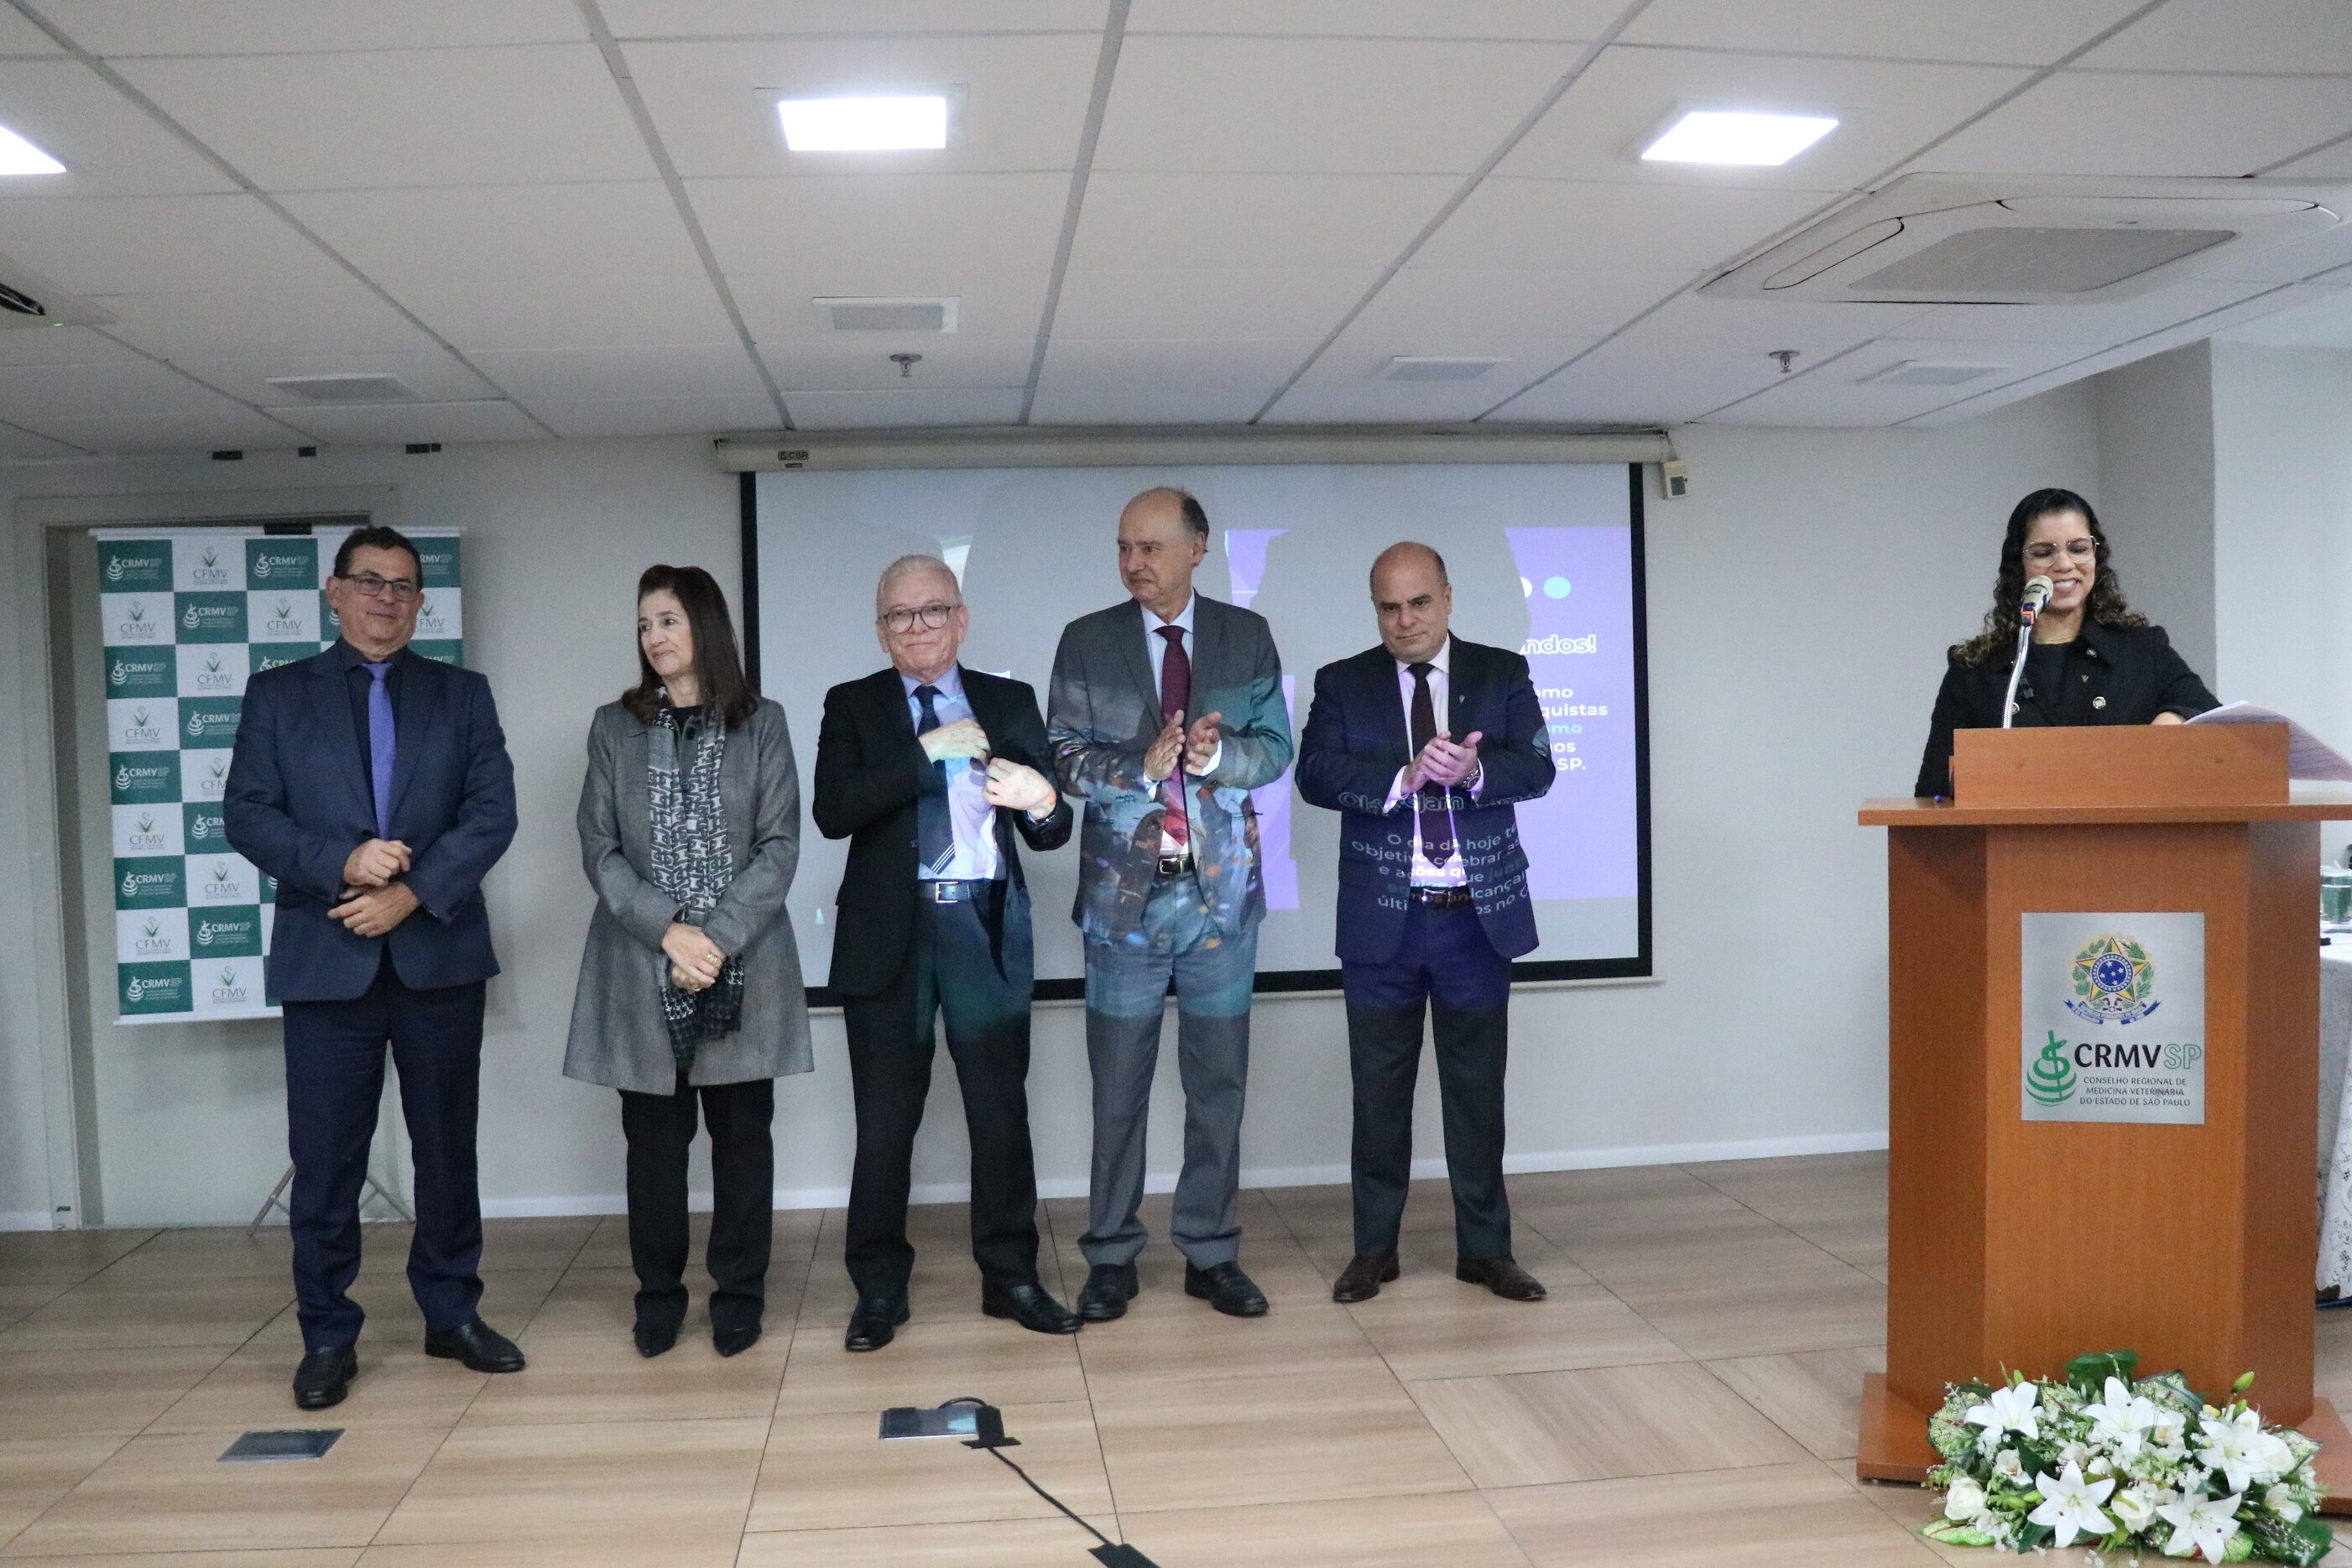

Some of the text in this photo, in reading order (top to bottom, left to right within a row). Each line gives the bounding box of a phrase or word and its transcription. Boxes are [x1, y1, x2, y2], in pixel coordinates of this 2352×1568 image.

[193, 569, 228, 579] CFMV
[120, 623, 156, 633] CFMV
[267, 620, 301, 630] CFMV
[417, 617, 445, 628] FMV
[197, 674, 232, 685] CFMV
[126, 728, 160, 739] CFMV
[1547, 724, 1583, 734] mo
[1555, 758, 1586, 770] SP.
[129, 834, 164, 845] CFMV
[1387, 834, 1401, 845] O
[1466, 836, 1501, 851] hoje
[205, 883, 239, 893] CFMV
[135, 939, 171, 950] CFMV
[212, 987, 248, 998] CFMV
[2142, 1097, 2161, 1106] SÃO
[2162, 1098, 2191, 1107] PAULO
